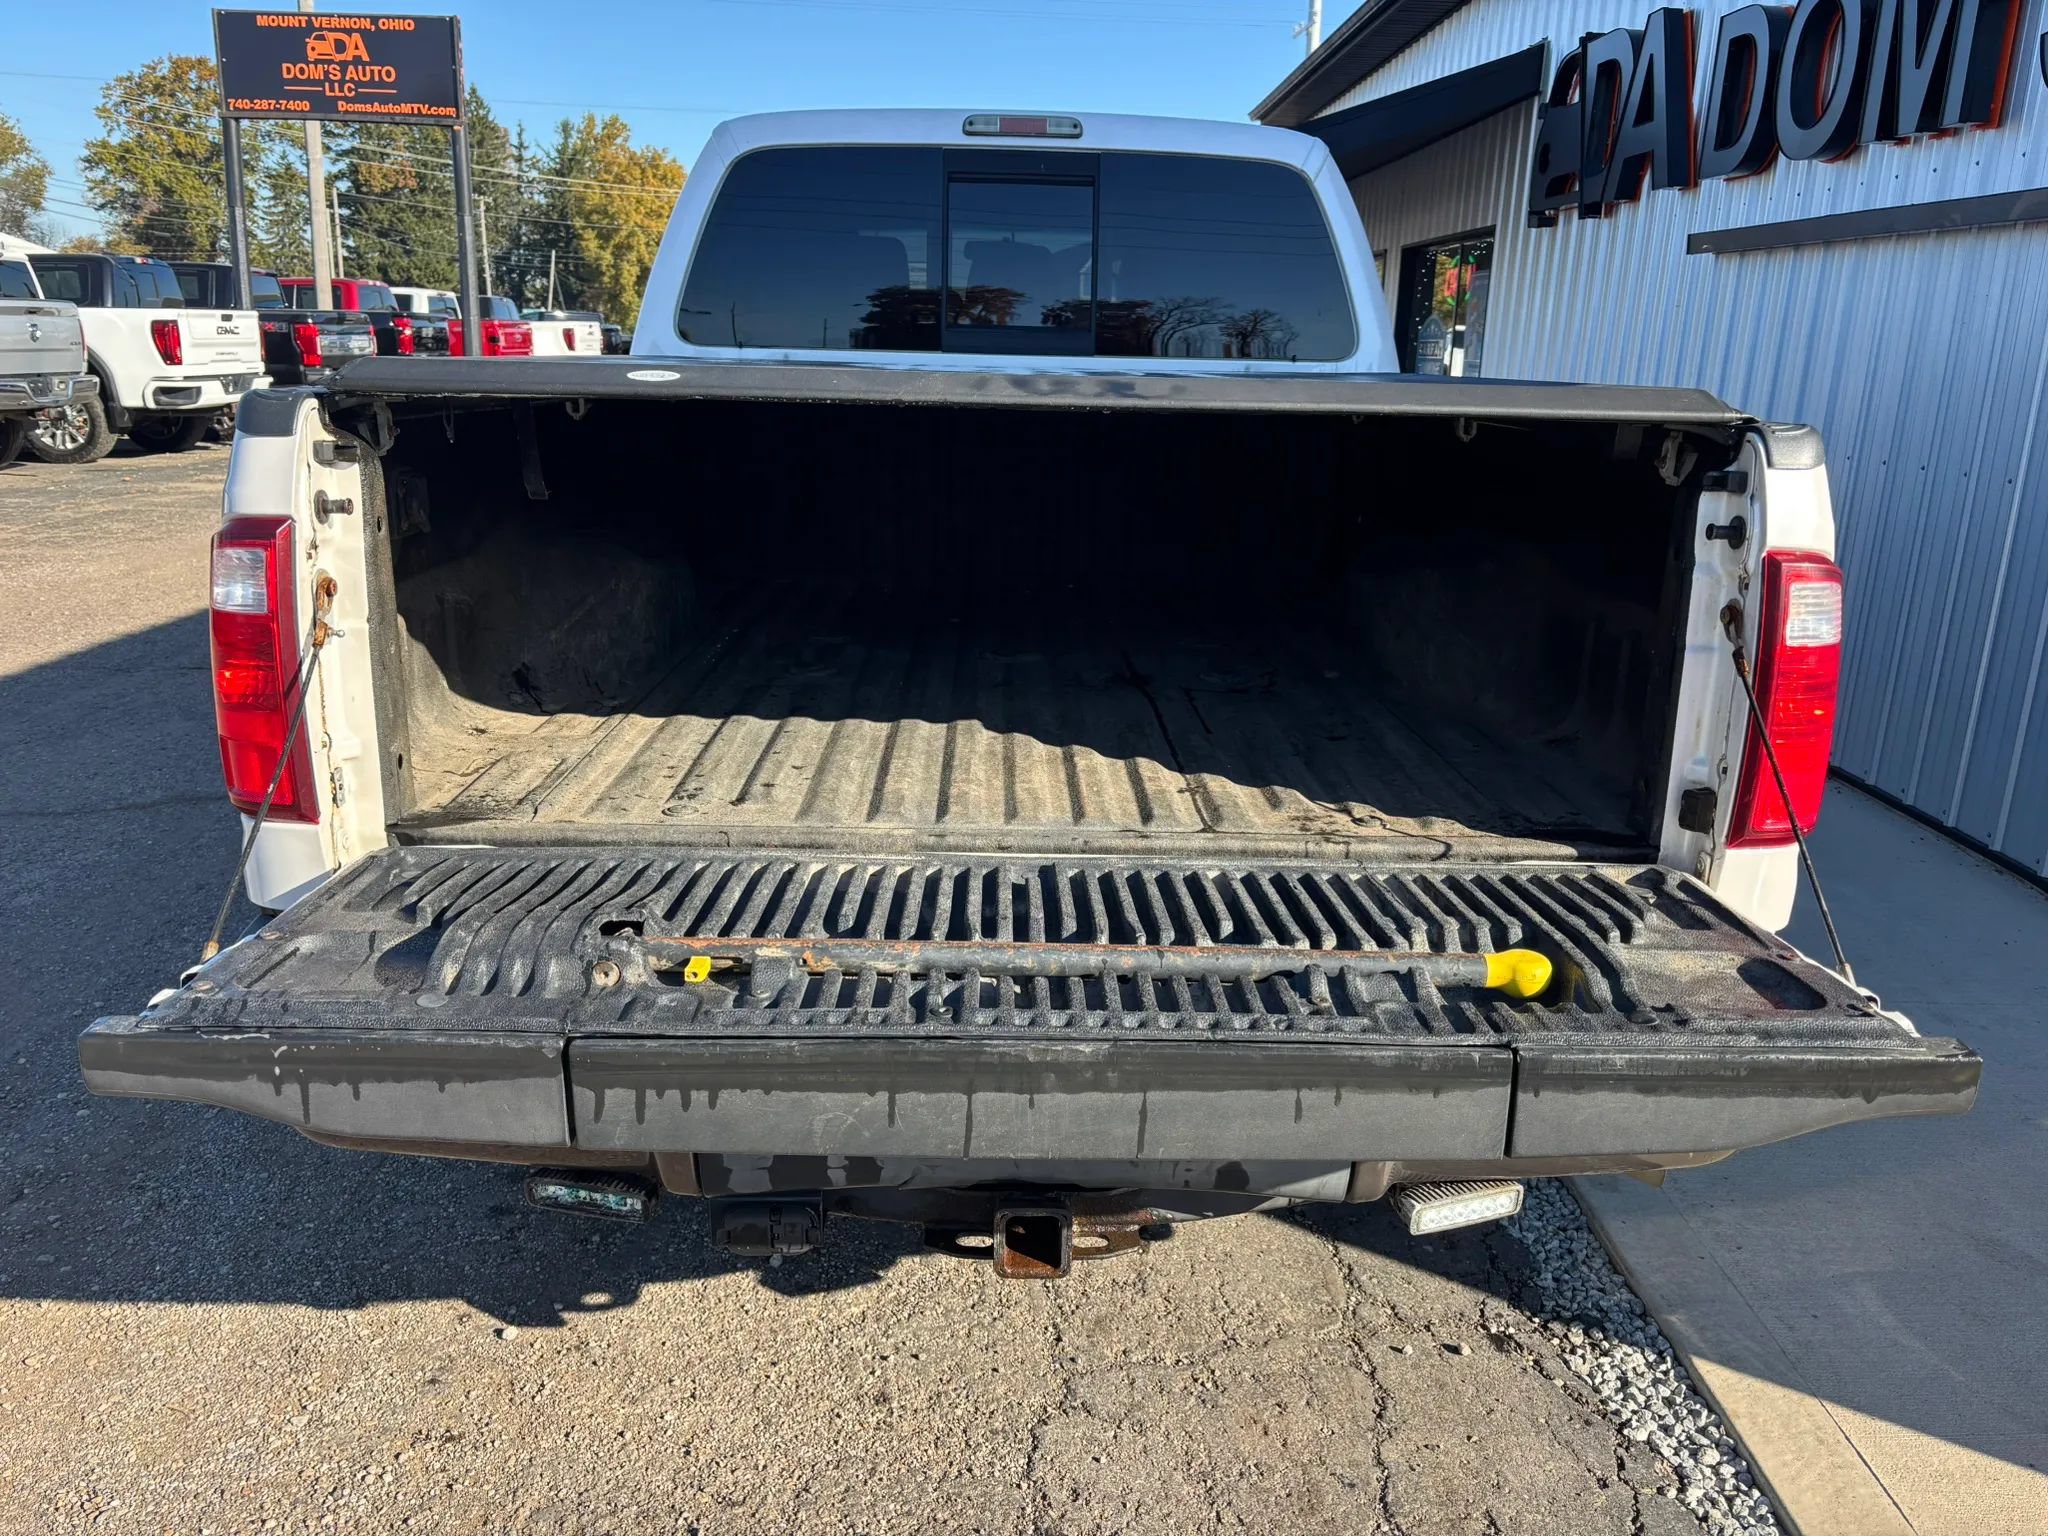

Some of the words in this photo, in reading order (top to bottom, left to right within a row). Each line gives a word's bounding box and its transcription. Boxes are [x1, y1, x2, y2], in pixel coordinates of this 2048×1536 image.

[256, 15, 308, 28] MOUNT
[312, 16, 376, 31] VERNON,
[378, 18, 415, 31] OHIO
[282, 63, 341, 81] DOM'S
[345, 65, 396, 83] AUTO
[324, 82, 356, 97] LLC
[1700, 0, 2048, 178] DOM
[228, 99, 310, 111] 740-287-7400
[338, 101, 456, 117] DomsAutoMTV.com
[216, 326, 240, 335] GMC
